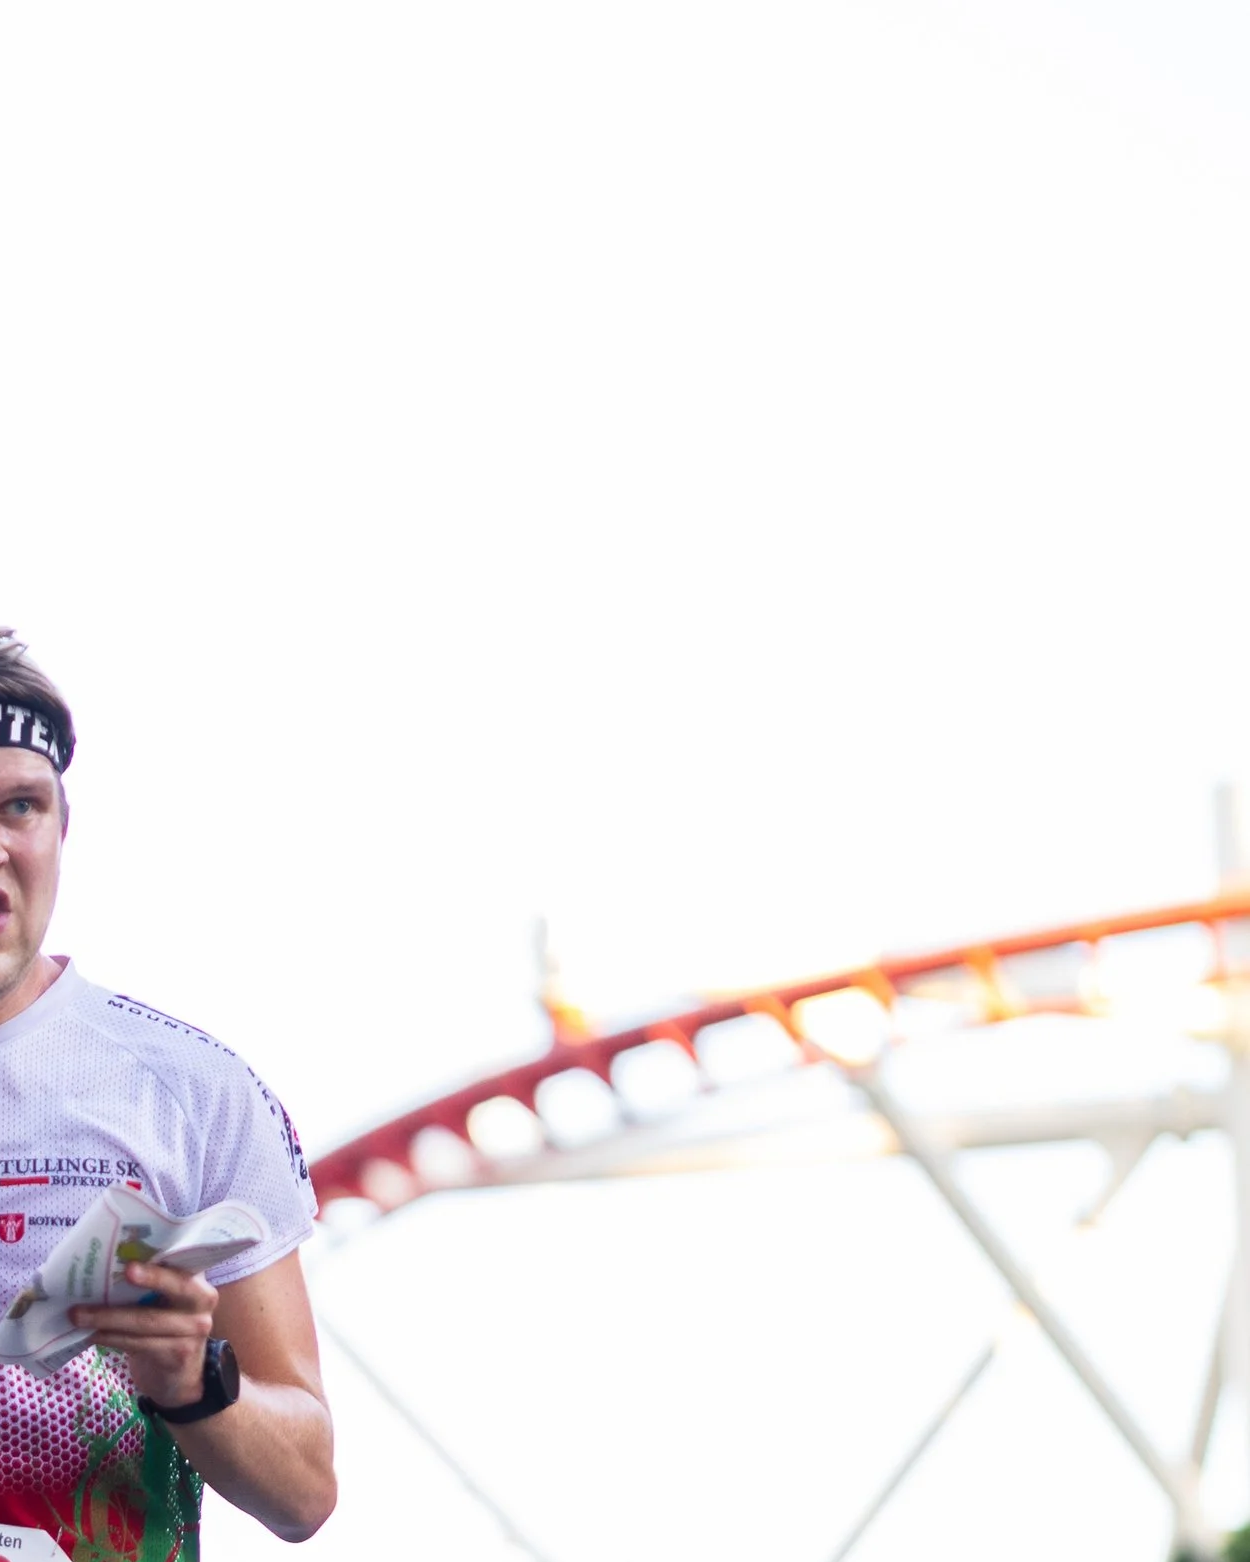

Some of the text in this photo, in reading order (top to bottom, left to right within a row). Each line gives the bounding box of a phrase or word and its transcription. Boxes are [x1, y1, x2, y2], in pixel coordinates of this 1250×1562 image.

[107, 999, 236, 1057] MOUNTAIN
[0, 1157, 142, 1178] TULLINGE SK
[51, 1175, 121, 1187] BOTKYRK
